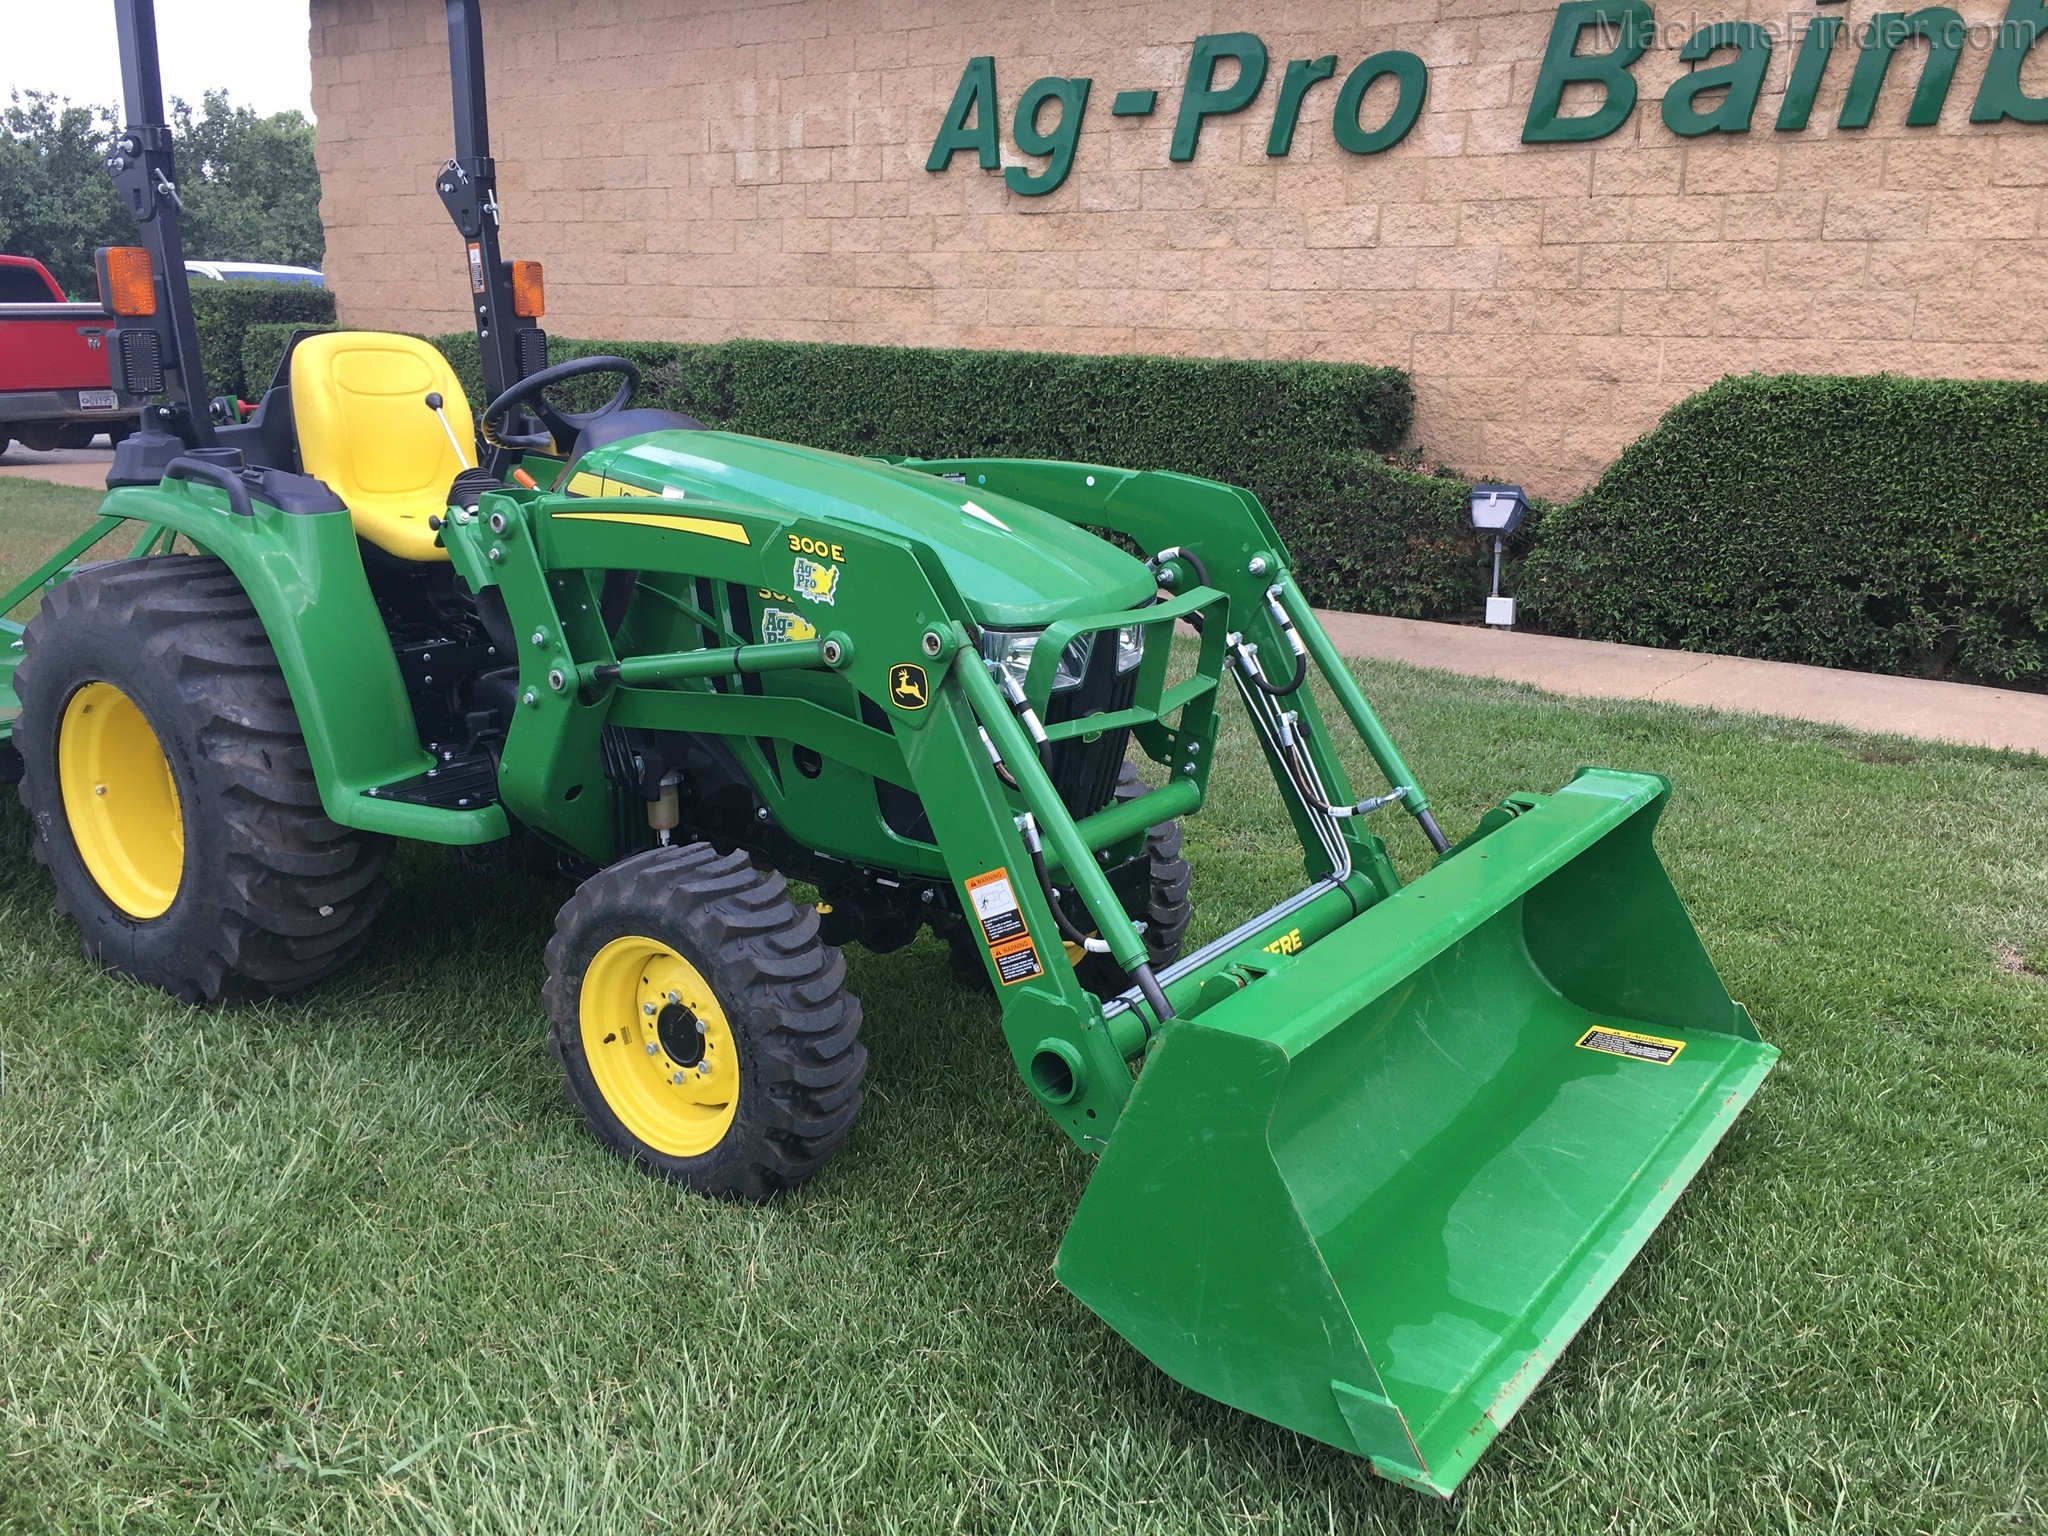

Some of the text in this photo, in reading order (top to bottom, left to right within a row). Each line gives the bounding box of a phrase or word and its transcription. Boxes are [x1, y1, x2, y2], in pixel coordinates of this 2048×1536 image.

[925, 32, 1429, 196] Ag-Pro
[787, 534, 847, 564] 300E
[796, 560, 817, 578] Ag-
[796, 573, 817, 589] Pro
[765, 612, 793, 637] Ag-
[976, 872, 1002, 885] WARNING
[1002, 941, 1028, 953] WARNING
